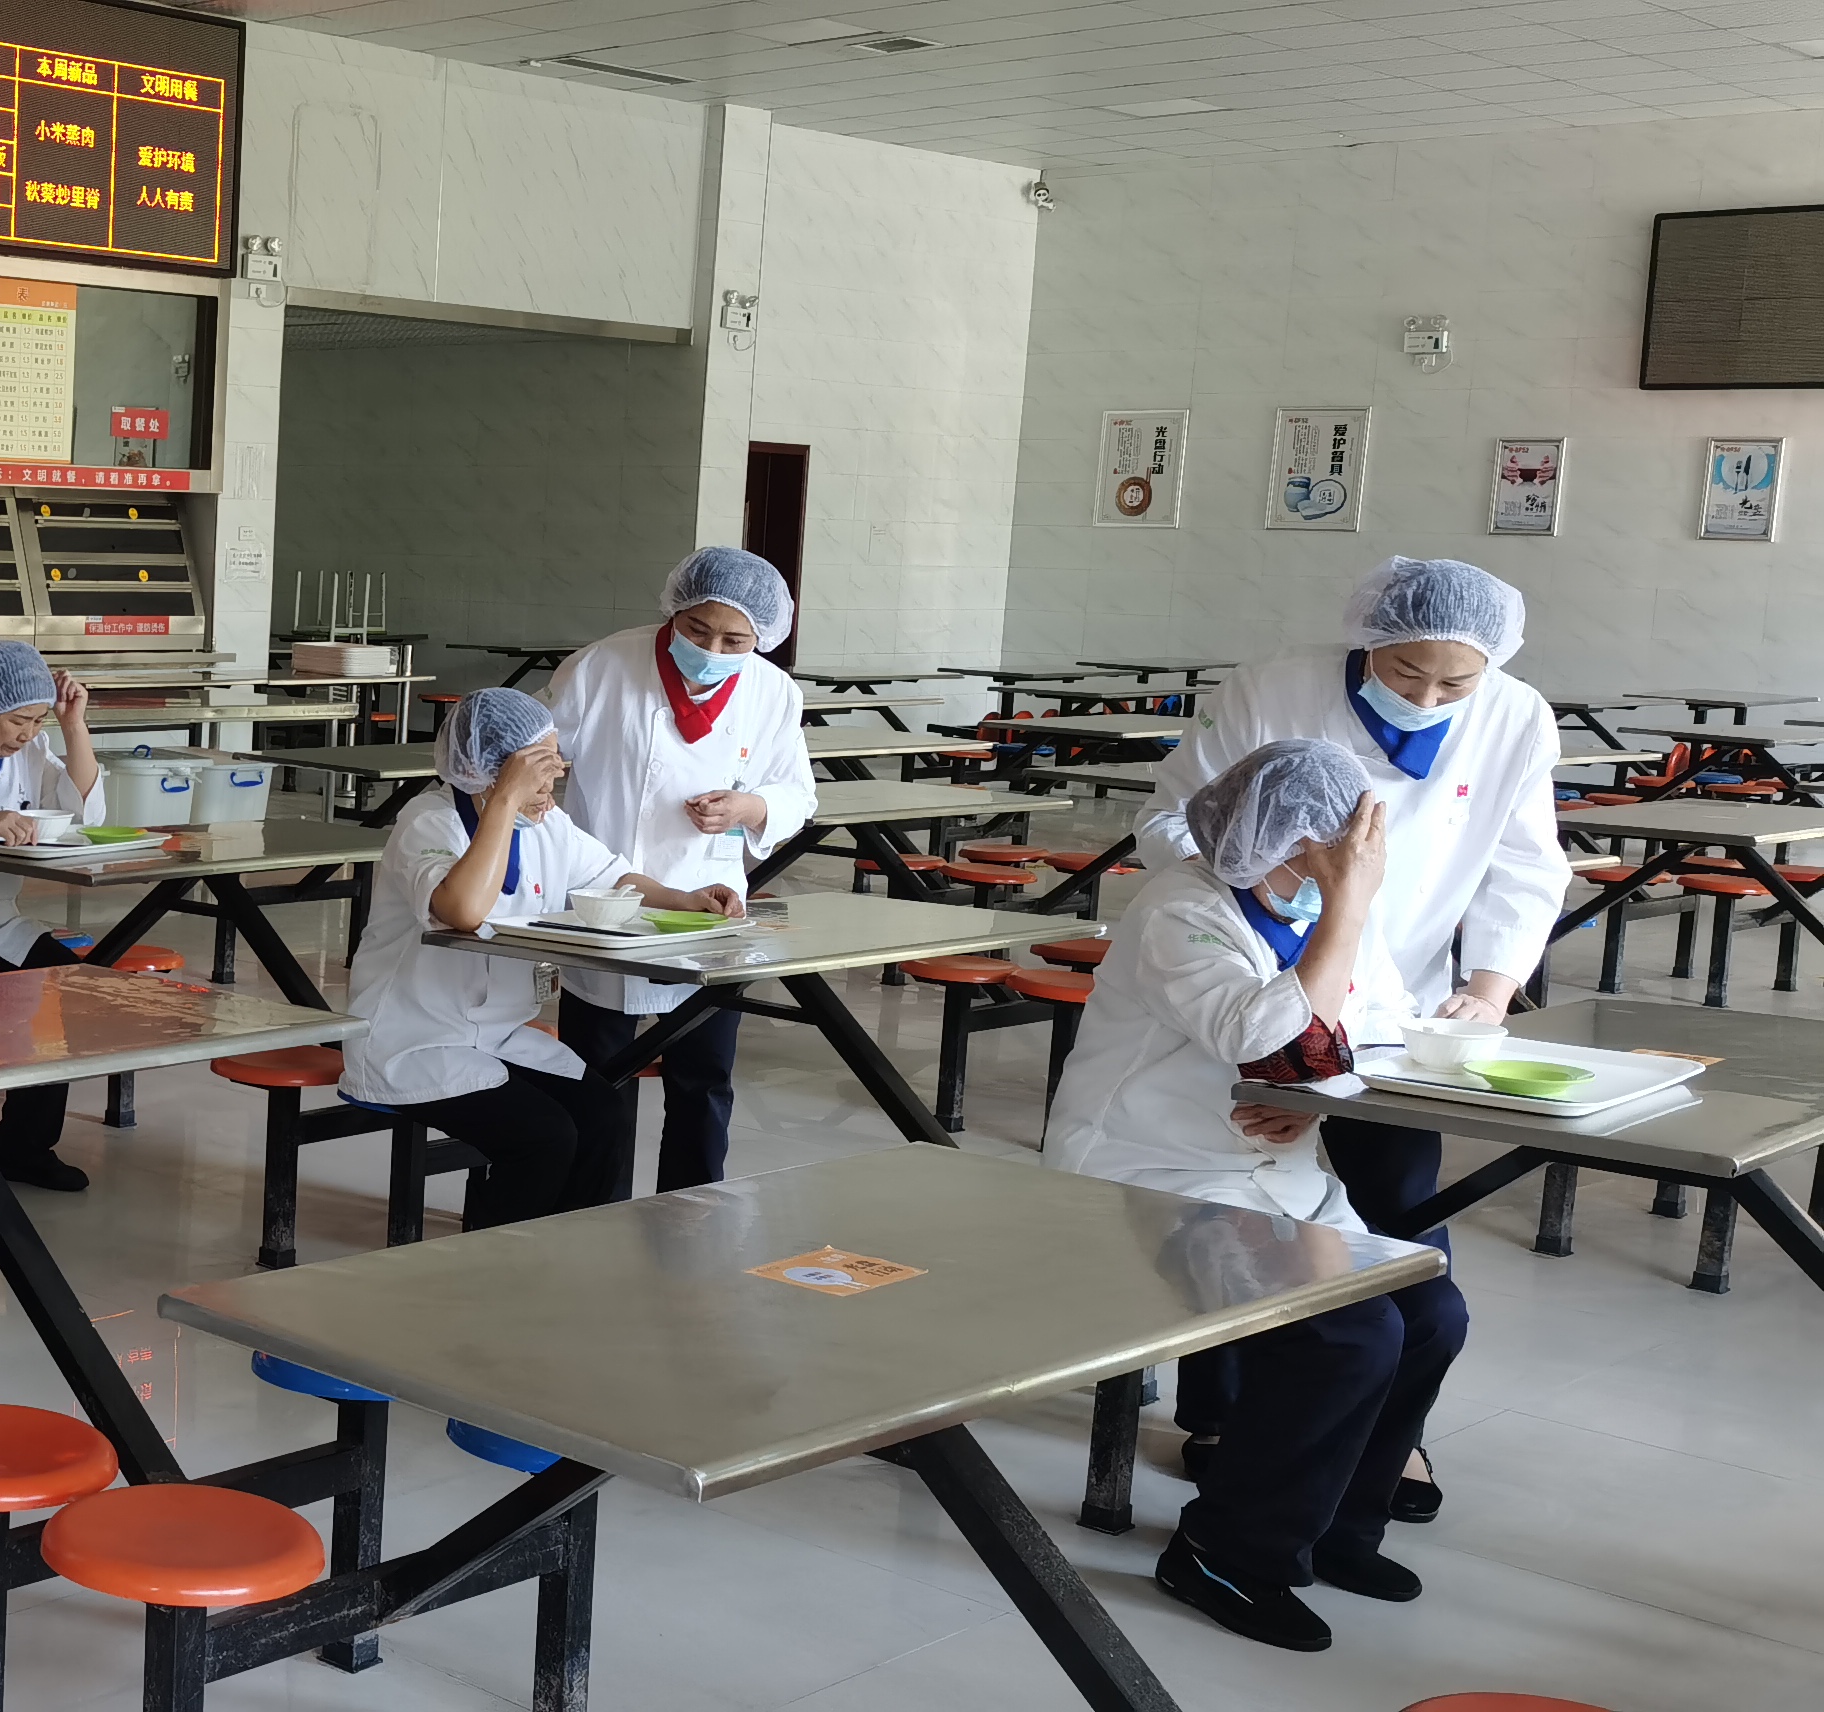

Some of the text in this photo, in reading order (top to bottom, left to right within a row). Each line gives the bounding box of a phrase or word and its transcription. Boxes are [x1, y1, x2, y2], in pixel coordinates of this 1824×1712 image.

[37, 57, 97, 85] 本周新品
[140, 74, 198, 101] 文明用餐
[35, 120, 94, 147] 小米蒸肉
[139, 146, 195, 173] 爱护环境
[26, 181, 99, 209] 秋葵炒里脊
[137, 186, 193, 211] 人人有责
[120, 417, 160, 432] 取餐处
[1152, 426, 1167, 474] 光盘行动
[1329, 424, 1348, 476] 爱护餐具
